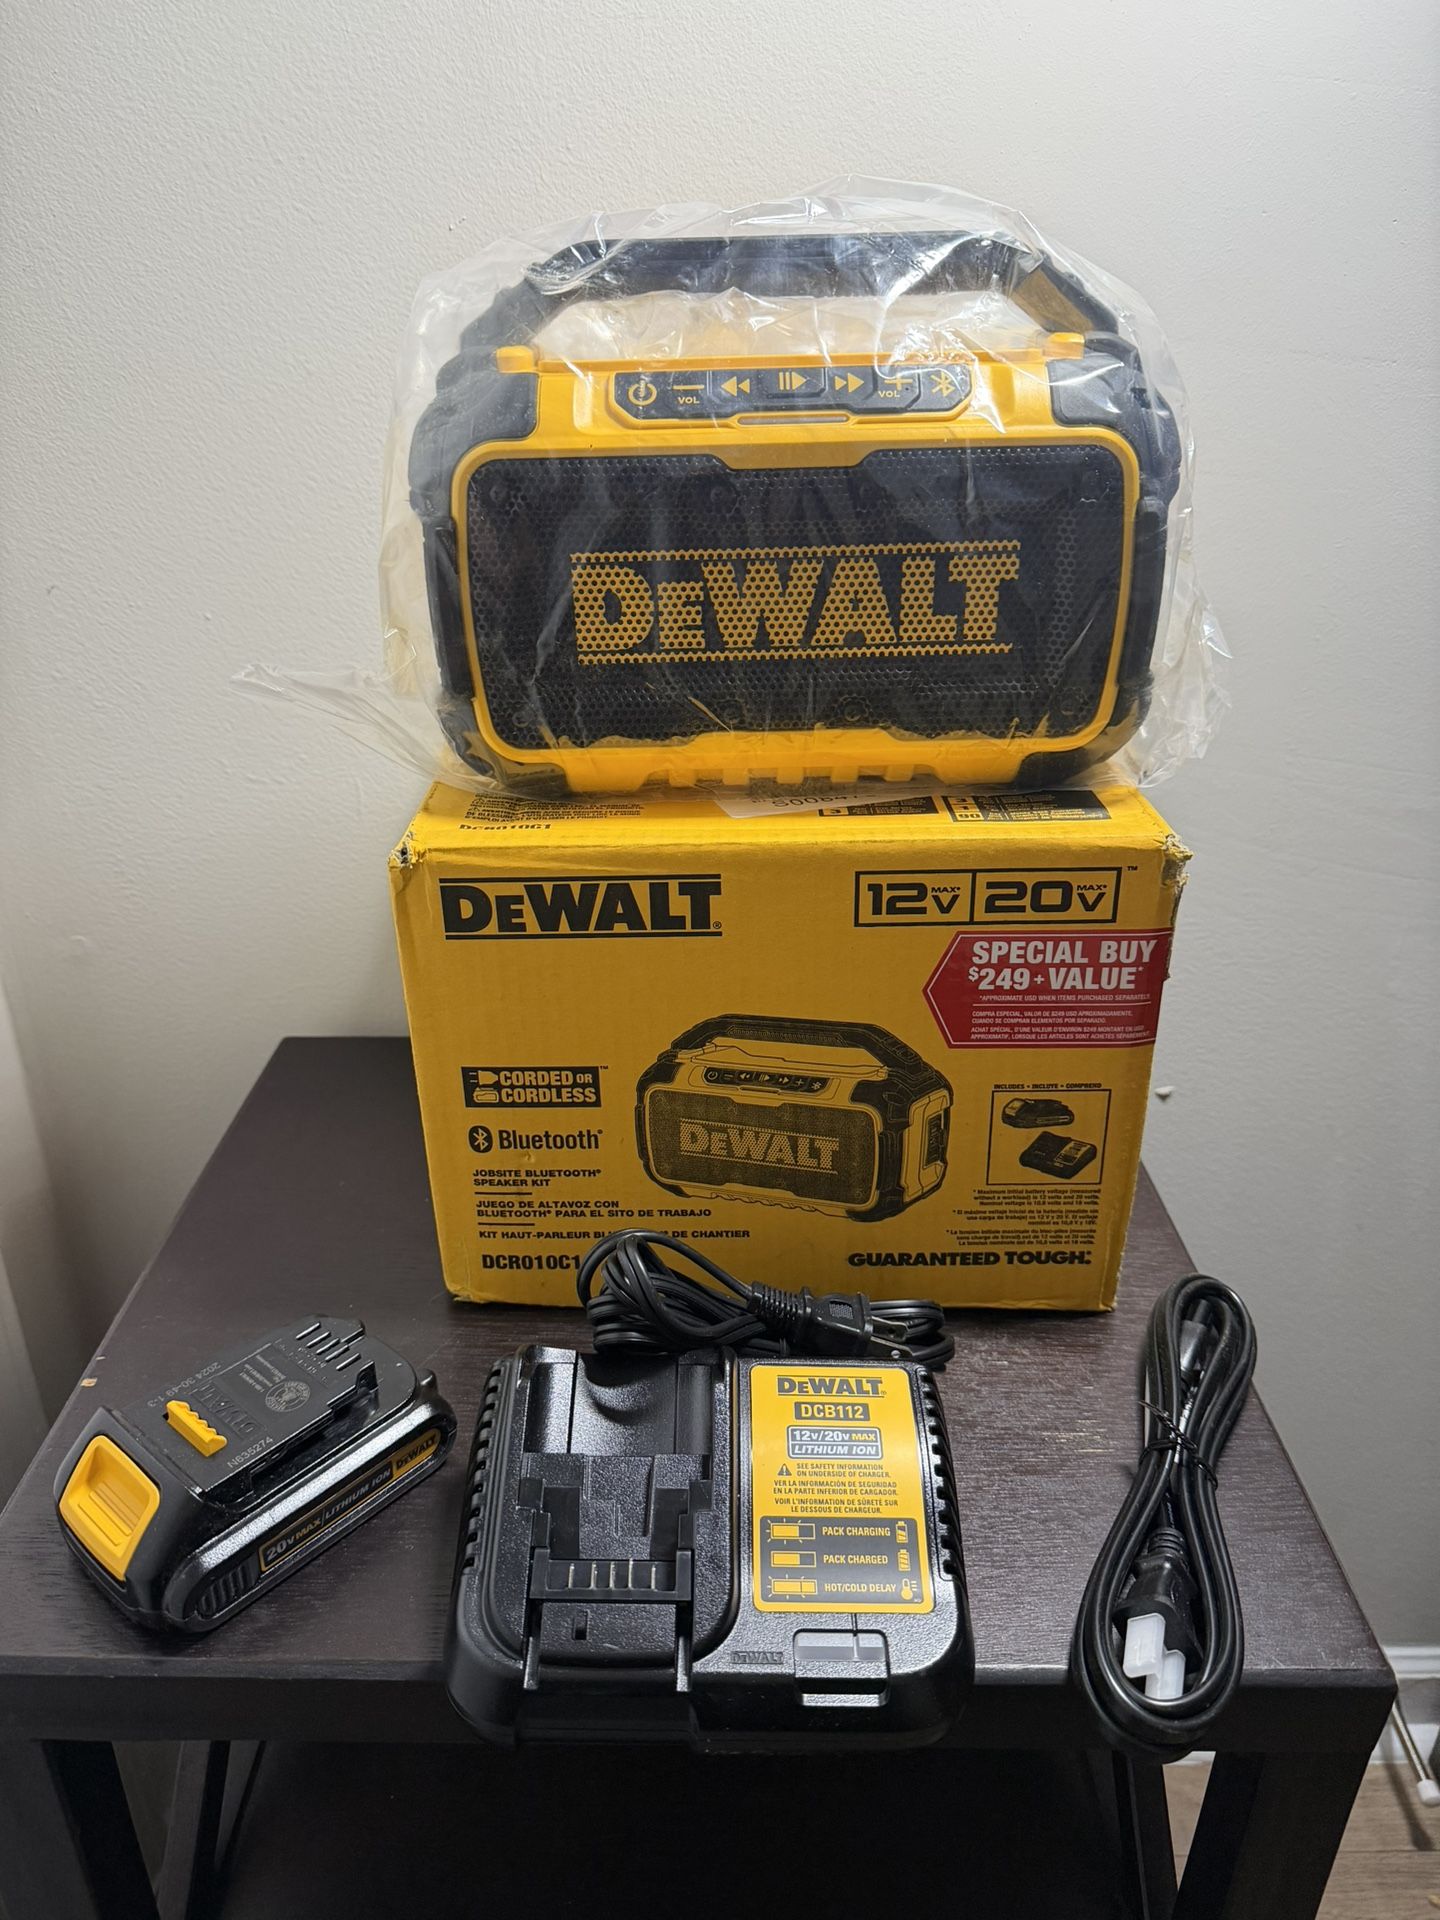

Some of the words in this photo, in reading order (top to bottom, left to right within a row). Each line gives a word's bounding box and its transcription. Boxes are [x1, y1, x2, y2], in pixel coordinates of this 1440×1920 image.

[878, 390, 900, 398] VOL
[571, 553, 1020, 652] DEWALT
[971, 941, 1088, 965] SPECIAL
[1099, 940, 1158, 964] BUY
[968, 966, 1030, 990] $249
[500, 1071, 573, 1086] CORDED
[576, 1073, 593, 1084] OR
[501, 1088, 596, 1103] CORDLESS
[679, 1122, 839, 1169] DEWALT
[473, 1179, 530, 1187] SPEAKER
[531, 1179, 550, 1187] KIT
[476, 1201, 515, 1209] JUEGO
[518, 1201, 535, 1209] DE
[538, 1201, 592, 1209] ALTAVOZ
[594, 1200, 619, 1208] CON
[555, 1209, 587, 1217] PARA
[590, 1209, 604, 1217] EL
[608, 1209, 634, 1217] SITO
[638, 1209, 654, 1217] DE
[658, 1209, 711, 1217] TRABAJO
[479, 1231, 498, 1239] KIT
[501, 1231, 591, 1239] HAUT-PARLEUR
[691, 1230, 750, 1238] CHANTIER
[482, 1254, 581, 1270] DCR010C1
[848, 1251, 1000, 1267] GUARANTEED
[800, 1404, 864, 1419] DCB112
[851, 1433, 876, 1441] MAX
[227, 1436, 273, 1468] N635274
[794, 1445, 849, 1454] LITHIUM
[852, 1446, 876, 1455] ION
[822, 1526, 844, 1535] PACK
[846, 1527, 891, 1536] CHARGING
[823, 1554, 846, 1563] PACK
[847, 1555, 888, 1564] CHARGED
[824, 1583, 867, 1592] HOT/COLD
[869, 1583, 897, 1592] DELAY
